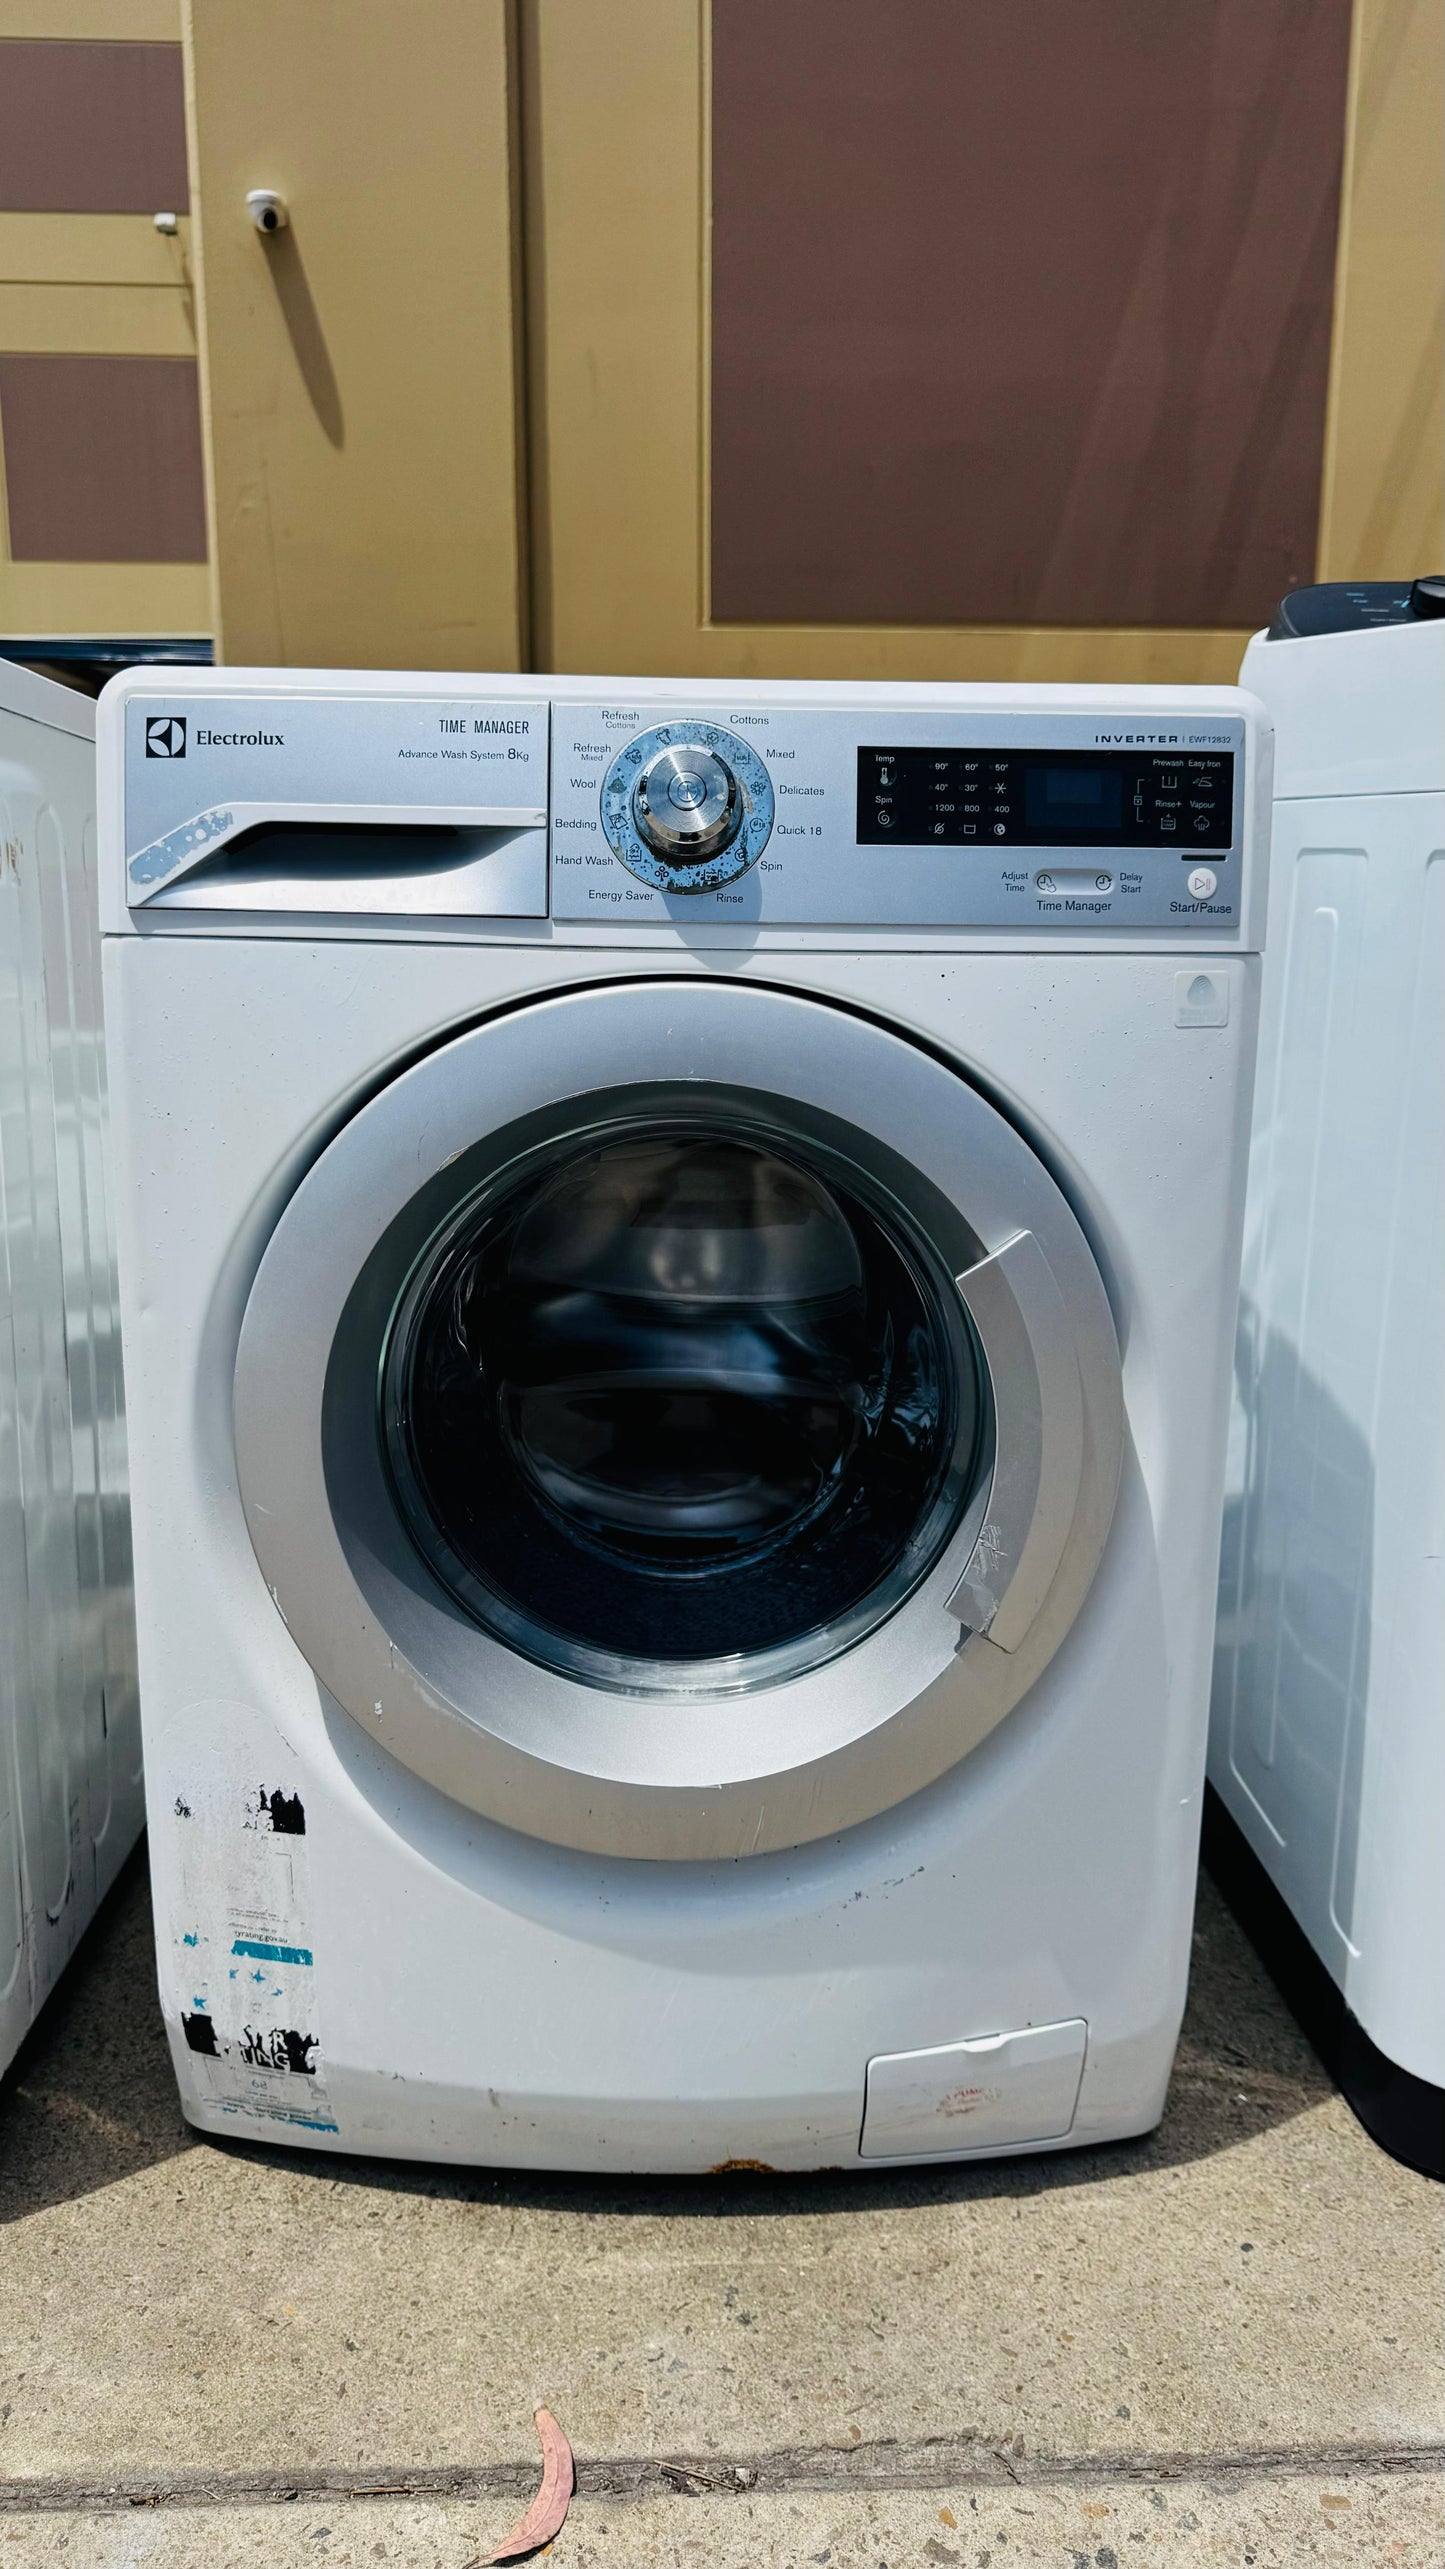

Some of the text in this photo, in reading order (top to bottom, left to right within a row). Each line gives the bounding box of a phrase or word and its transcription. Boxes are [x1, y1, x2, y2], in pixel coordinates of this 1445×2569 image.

[601, 710, 640, 722] Refresh
[729, 713, 770, 726] Cottons
[438, 719, 530, 735] TIME MANAGER
[605, 721, 636, 730] Cottons
[196, 730, 286, 746] Electrolux
[1095, 735, 1178, 744] INVERTER
[1188, 736, 1232, 744] EWF12832
[573, 743, 612, 754] Refresh
[766, 748, 795, 760] Mixed
[397, 747, 530, 763] Advance Wash System 8Kg
[580, 753, 604, 762] Mixed
[875, 754, 895, 763] Temp
[934, 762, 949, 771] 90°
[1152, 759, 1184, 768] Prewash
[1188, 759, 1221, 770] Easy Iron
[570, 778, 597, 789] Wool
[778, 784, 825, 797] Delicates
[875, 795, 893, 805] Spin
[1155, 800, 1182, 808] Rinse+
[935, 804, 955, 812] 1200
[964, 804, 980, 813] 800
[994, 805, 1010, 814] 400
[1190, 801, 1216, 811] Vapour
[554, 817, 598, 830] Bedding
[776, 824, 822, 837] Quick 18
[554, 854, 614, 867] Hand Wash
[760, 861, 783, 873] Spin
[1001, 871, 1029, 882] Adjust
[1119, 872, 1143, 884] Delay
[1005, 883, 1025, 893] Time
[1120, 884, 1141, 894] Start
[588, 888, 655, 903] Energy Saver
[716, 892, 744, 905] Rinse
[1036, 900, 1112, 913] Time Manager
[1169, 902, 1232, 914] Start/Pause
